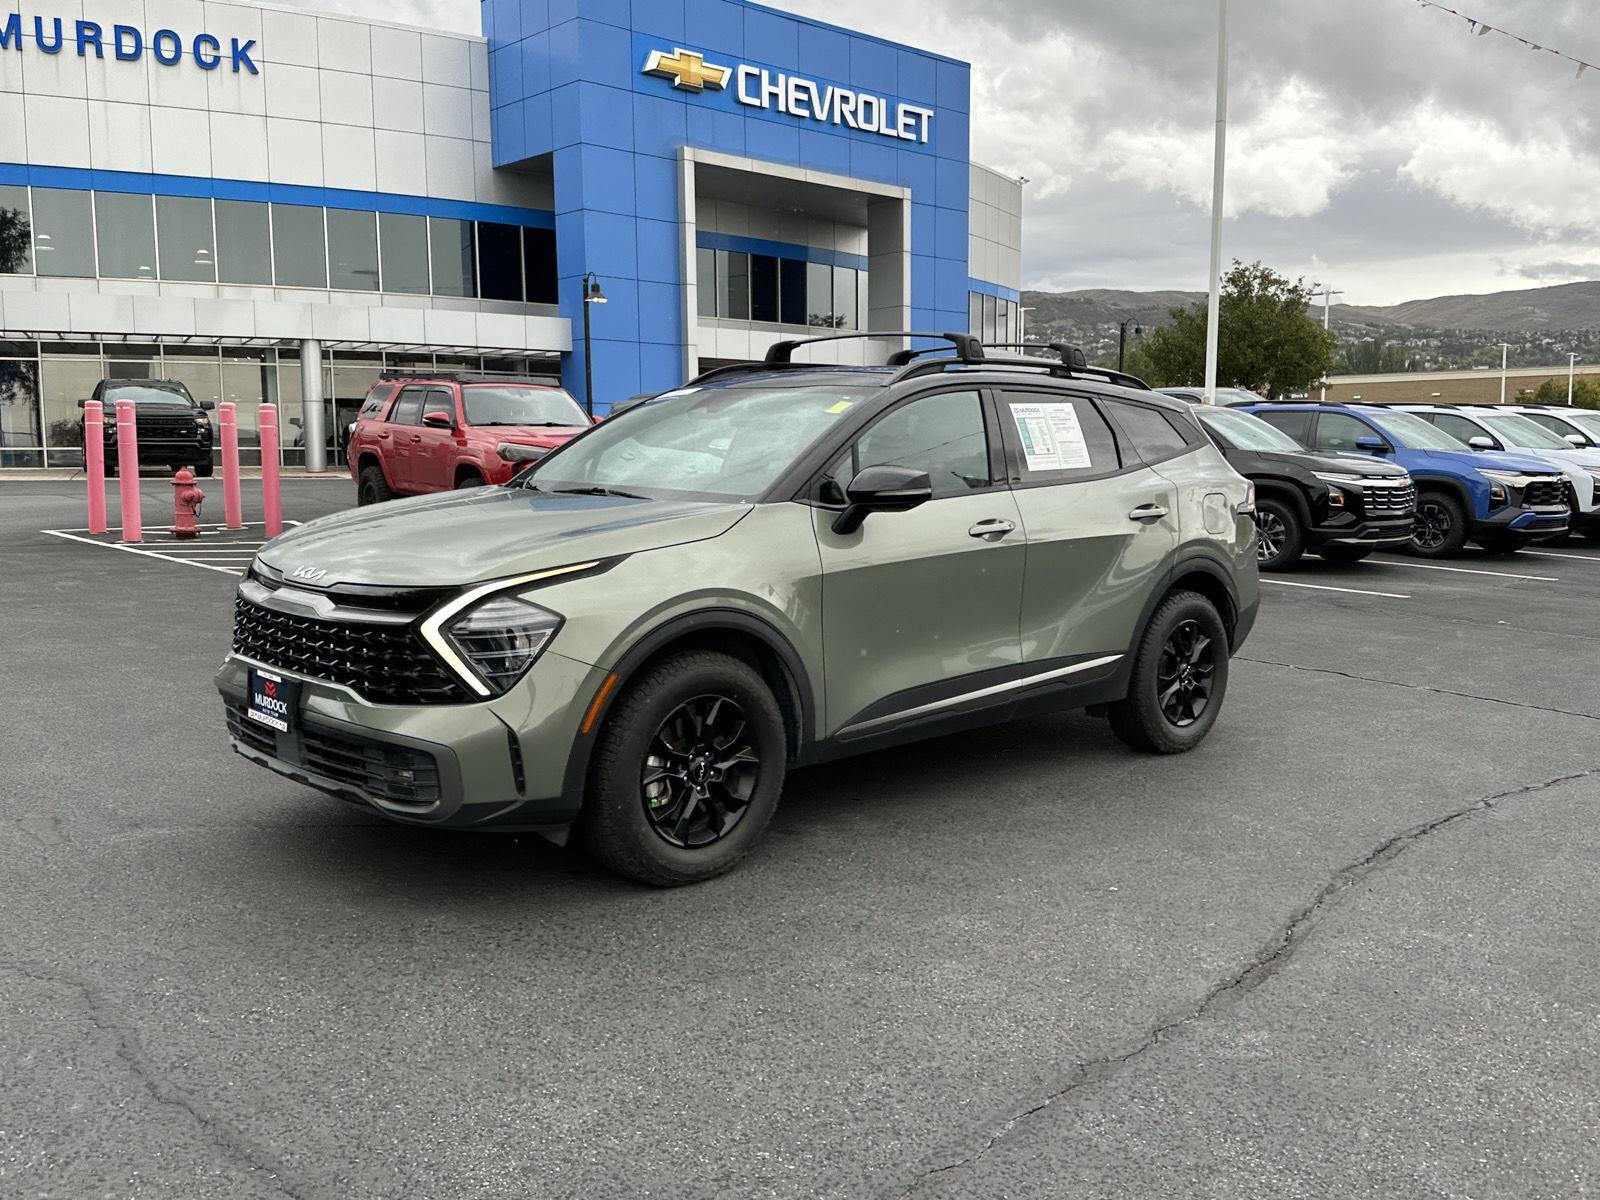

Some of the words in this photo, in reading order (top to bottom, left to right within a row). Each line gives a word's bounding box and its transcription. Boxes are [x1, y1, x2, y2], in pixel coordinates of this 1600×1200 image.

[0, 13, 259, 75] MURDOCK
[737, 64, 934, 143] CHEVROLET
[254, 692, 288, 715] MURDOCK
